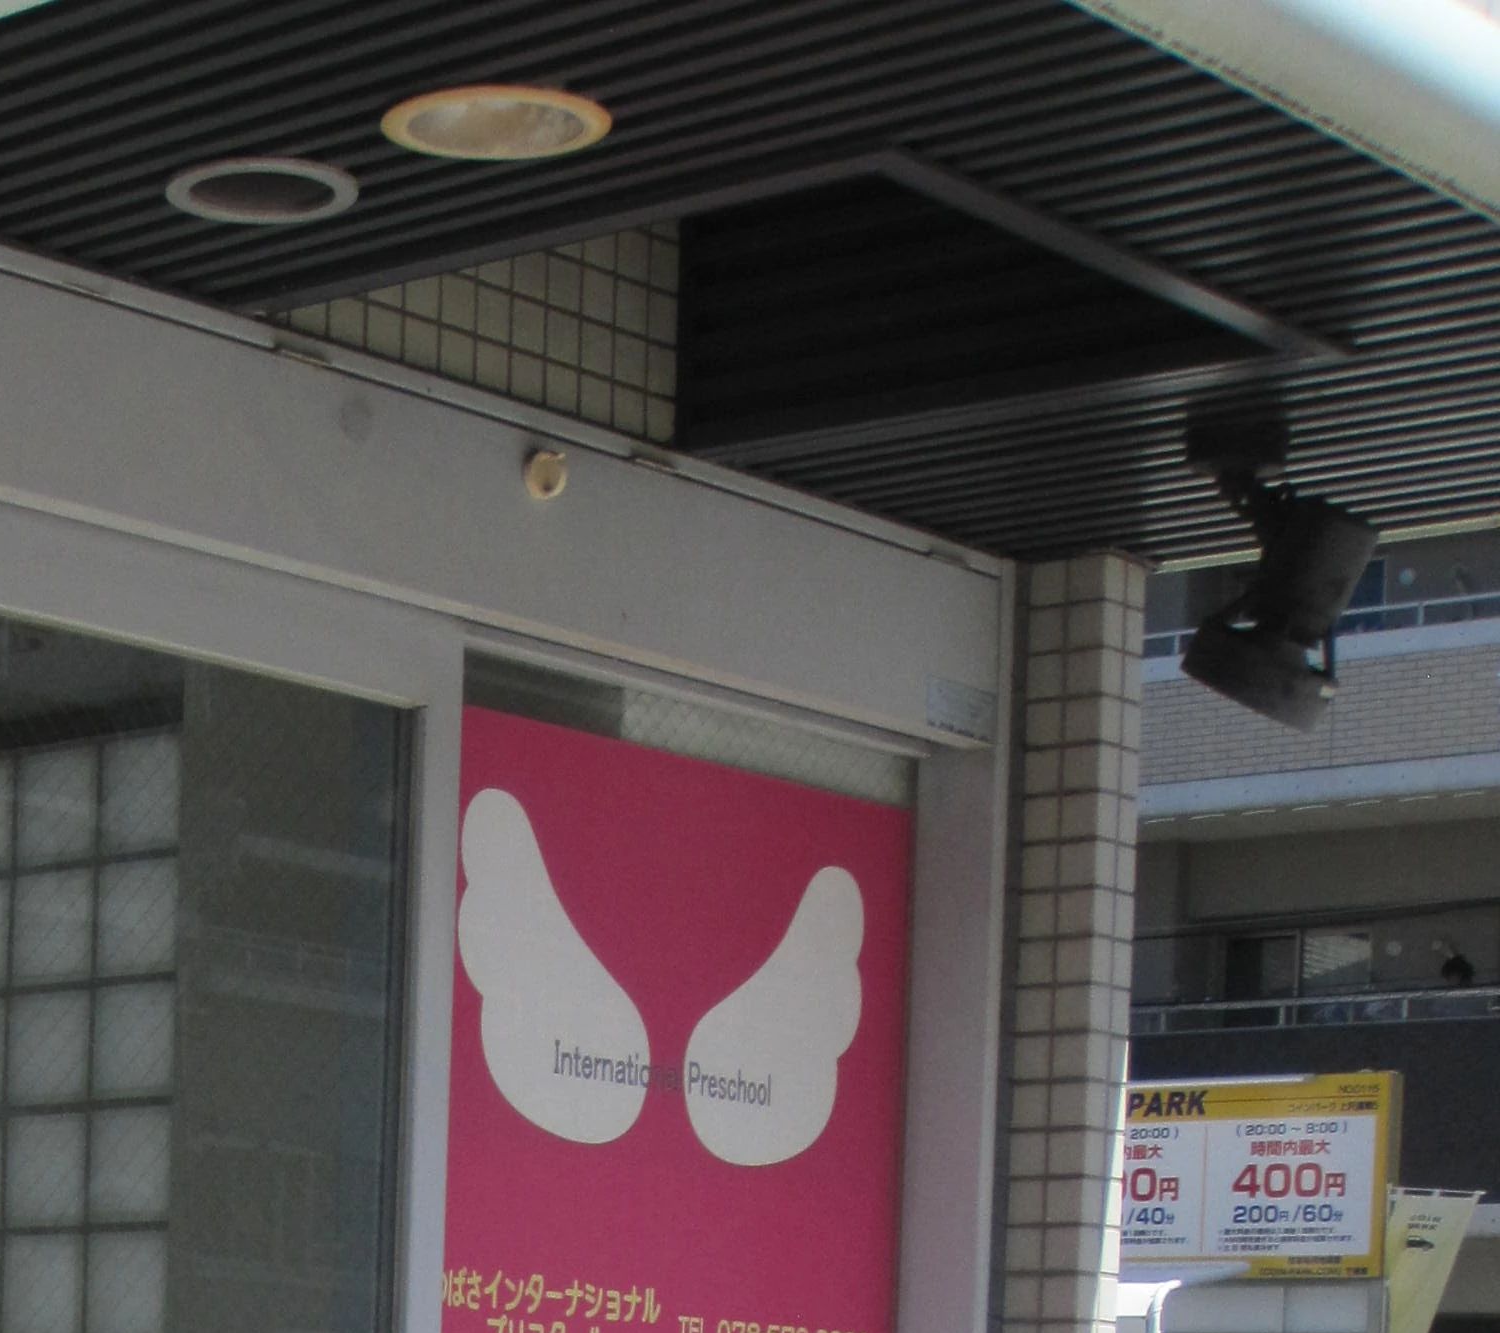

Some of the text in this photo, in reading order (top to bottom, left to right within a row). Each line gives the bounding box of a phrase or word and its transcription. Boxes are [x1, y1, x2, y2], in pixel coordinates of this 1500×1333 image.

[688, 1060, 772, 1107] Preschool
[1127, 1090, 1208, 1117] PARK
[1250, 1139, 1331, 1156] 時間内最大
[1232, 1162, 1346, 1198] 400円
